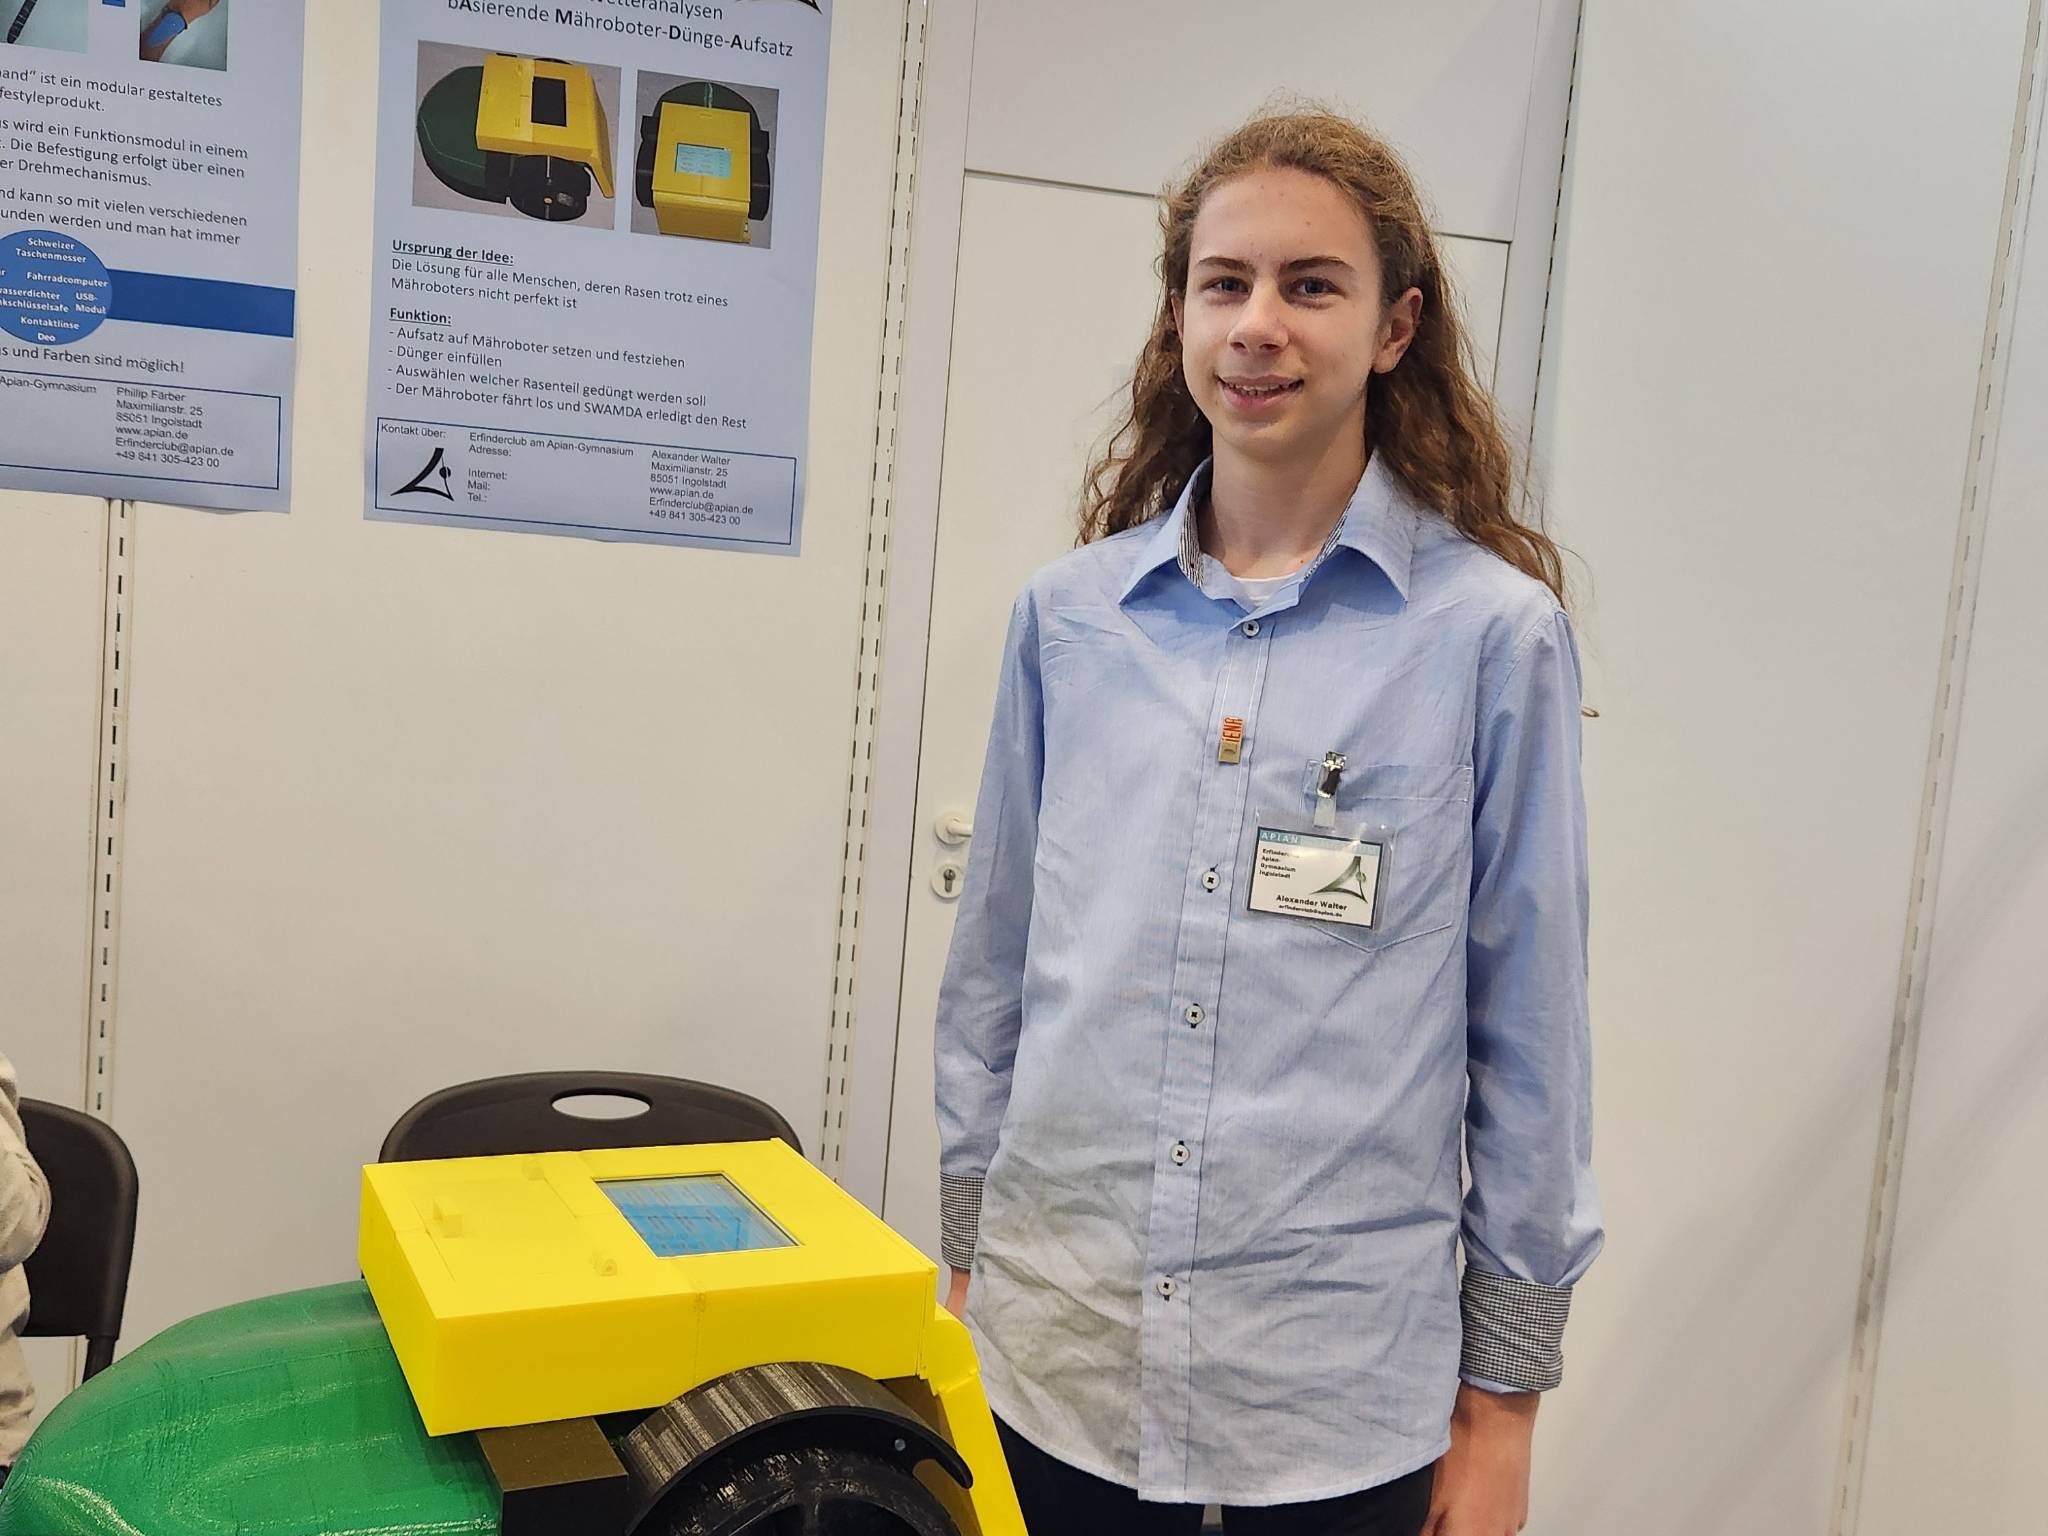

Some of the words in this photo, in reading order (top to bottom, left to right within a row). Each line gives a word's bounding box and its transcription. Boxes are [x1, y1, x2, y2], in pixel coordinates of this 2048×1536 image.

[448, 0, 549, 21] bAsierende
[555, 9, 793, 57] Mähroboter-Dünge-Aufsatz
[41, 72, 56, 85] ist
[61, 75, 81, 88] ein
[87, 81, 145, 96] modular
[149, 89, 222, 106] gestaltetes
[13, 120, 43, 135] wird
[48, 124, 69, 136] ein
[75, 126, 185, 151] Funktionsmodul
[190, 140, 201, 153] in
[206, 144, 248, 159] einem
[11, 138, 32, 152] Die
[38, 141, 118, 165] Befestigung
[123, 153, 168, 170] erfolgt
[172, 158, 204, 173] über
[207, 163, 245, 178] einen
[19, 159, 151, 186] Drehmechanismus.
[20, 188, 52, 204] kann
[57, 196, 72, 205] so
[77, 197, 100, 209] mit
[104, 200, 144, 214] vielen
[149, 207, 247, 226] verschiedenen
[49, 215, 101, 229] werden
[106, 221, 132, 232] und
[136, 225, 166, 237] man
[171, 225, 192, 239] hat
[197, 229, 240, 244] immer
[28, 238, 74, 249] Schweizer
[16, 248, 86, 263] Taschenmesser
[392, 240, 454, 259] Ursprung
[456, 246, 479, 262] der
[481, 249, 514, 266] Idee:
[27, 272, 108, 287] Fahrradcomputer
[392, 259, 412, 271] Die
[417, 261, 460, 278] Lösung
[465, 266, 483, 278] für
[487, 269, 508, 282] alle
[513, 272, 580, 292] Menschen,
[585, 280, 621, 294] deren
[625, 285, 660, 299] Rasen
[665, 290, 692, 303] trotz
[697, 294, 728, 307] eines
[392, 278, 474, 296] Mähroboters
[479, 288, 510, 301] nicht
[514, 293, 559, 306] perfekt
[563, 296, 577, 308] ist
[76, 304, 106, 314] Modul
[389, 307, 452, 325] Funktion:
[21, 316, 80, 329] Kontaktlinse
[38, 333, 56, 341] Deo
[397, 327, 444, 342] Aufsatz
[448, 333, 469, 344] auf
[473, 335, 549, 353] Mähroboter
[552, 346, 591, 358] setzen
[596, 350, 619, 360] und
[623, 351, 684, 368] festziehen
[13, 347, 38, 359] und
[44, 349, 90, 363] Farben
[94, 354, 122, 367] sind
[126, 358, 184, 373] möglich!
[397, 346, 443, 362] Dünger
[448, 351, 501, 367] einfüllen
[0, 376, 97, 393] Apian-Gymnasium
[396, 365, 465, 381] Auswählen
[470, 373, 520, 387] welcher
[523, 377, 579, 394] Rasenteil
[583, 385, 634, 401] gedüngt
[637, 391, 684, 404] werden
[687, 395, 706, 406] soll
[396, 383, 419, 395] Der
[423, 385, 499, 403] Mähroboter
[503, 393, 532, 407] fährt
[536, 396, 553, 409] los
[557, 401, 580, 412] und
[584, 402, 643, 419] SWAMDA
[646, 409, 692, 425] erledigt
[696, 412, 717, 426] den
[722, 416, 746, 429] Rest
[381, 423, 419, 436] Kontakt
[421, 428, 446, 438] über:
[469, 444, 511, 456] Adresse:
[470, 432, 527, 446] Erfinderclub
[530, 440, 544, 448] am
[546, 440, 633, 456] Apian-Gymnasium
[652, 450, 699, 462] Alexander
[701, 454, 731, 465] Walter
[469, 468, 507, 481] Internet:
[651, 461, 713, 476] Maximilianstr.
[716, 468, 728, 477] 25
[468, 479, 490, 491] Mail:
[682, 476, 726, 488] Ingolstadt
[467, 492, 487, 502] Tel.:
[650, 486, 714, 499] www.apian.de
[650, 497, 753, 515] Erfinderclub@apian.de
[649, 509, 666, 518] +49
[669, 510, 685, 520] 841
[689, 512, 726, 524] 305-423
[729, 516, 740, 525] 00
[1261, 831, 1298, 843] APIAN
[1276, 895, 1318, 907] Alexander
[1319, 899, 1347, 911] Walter
